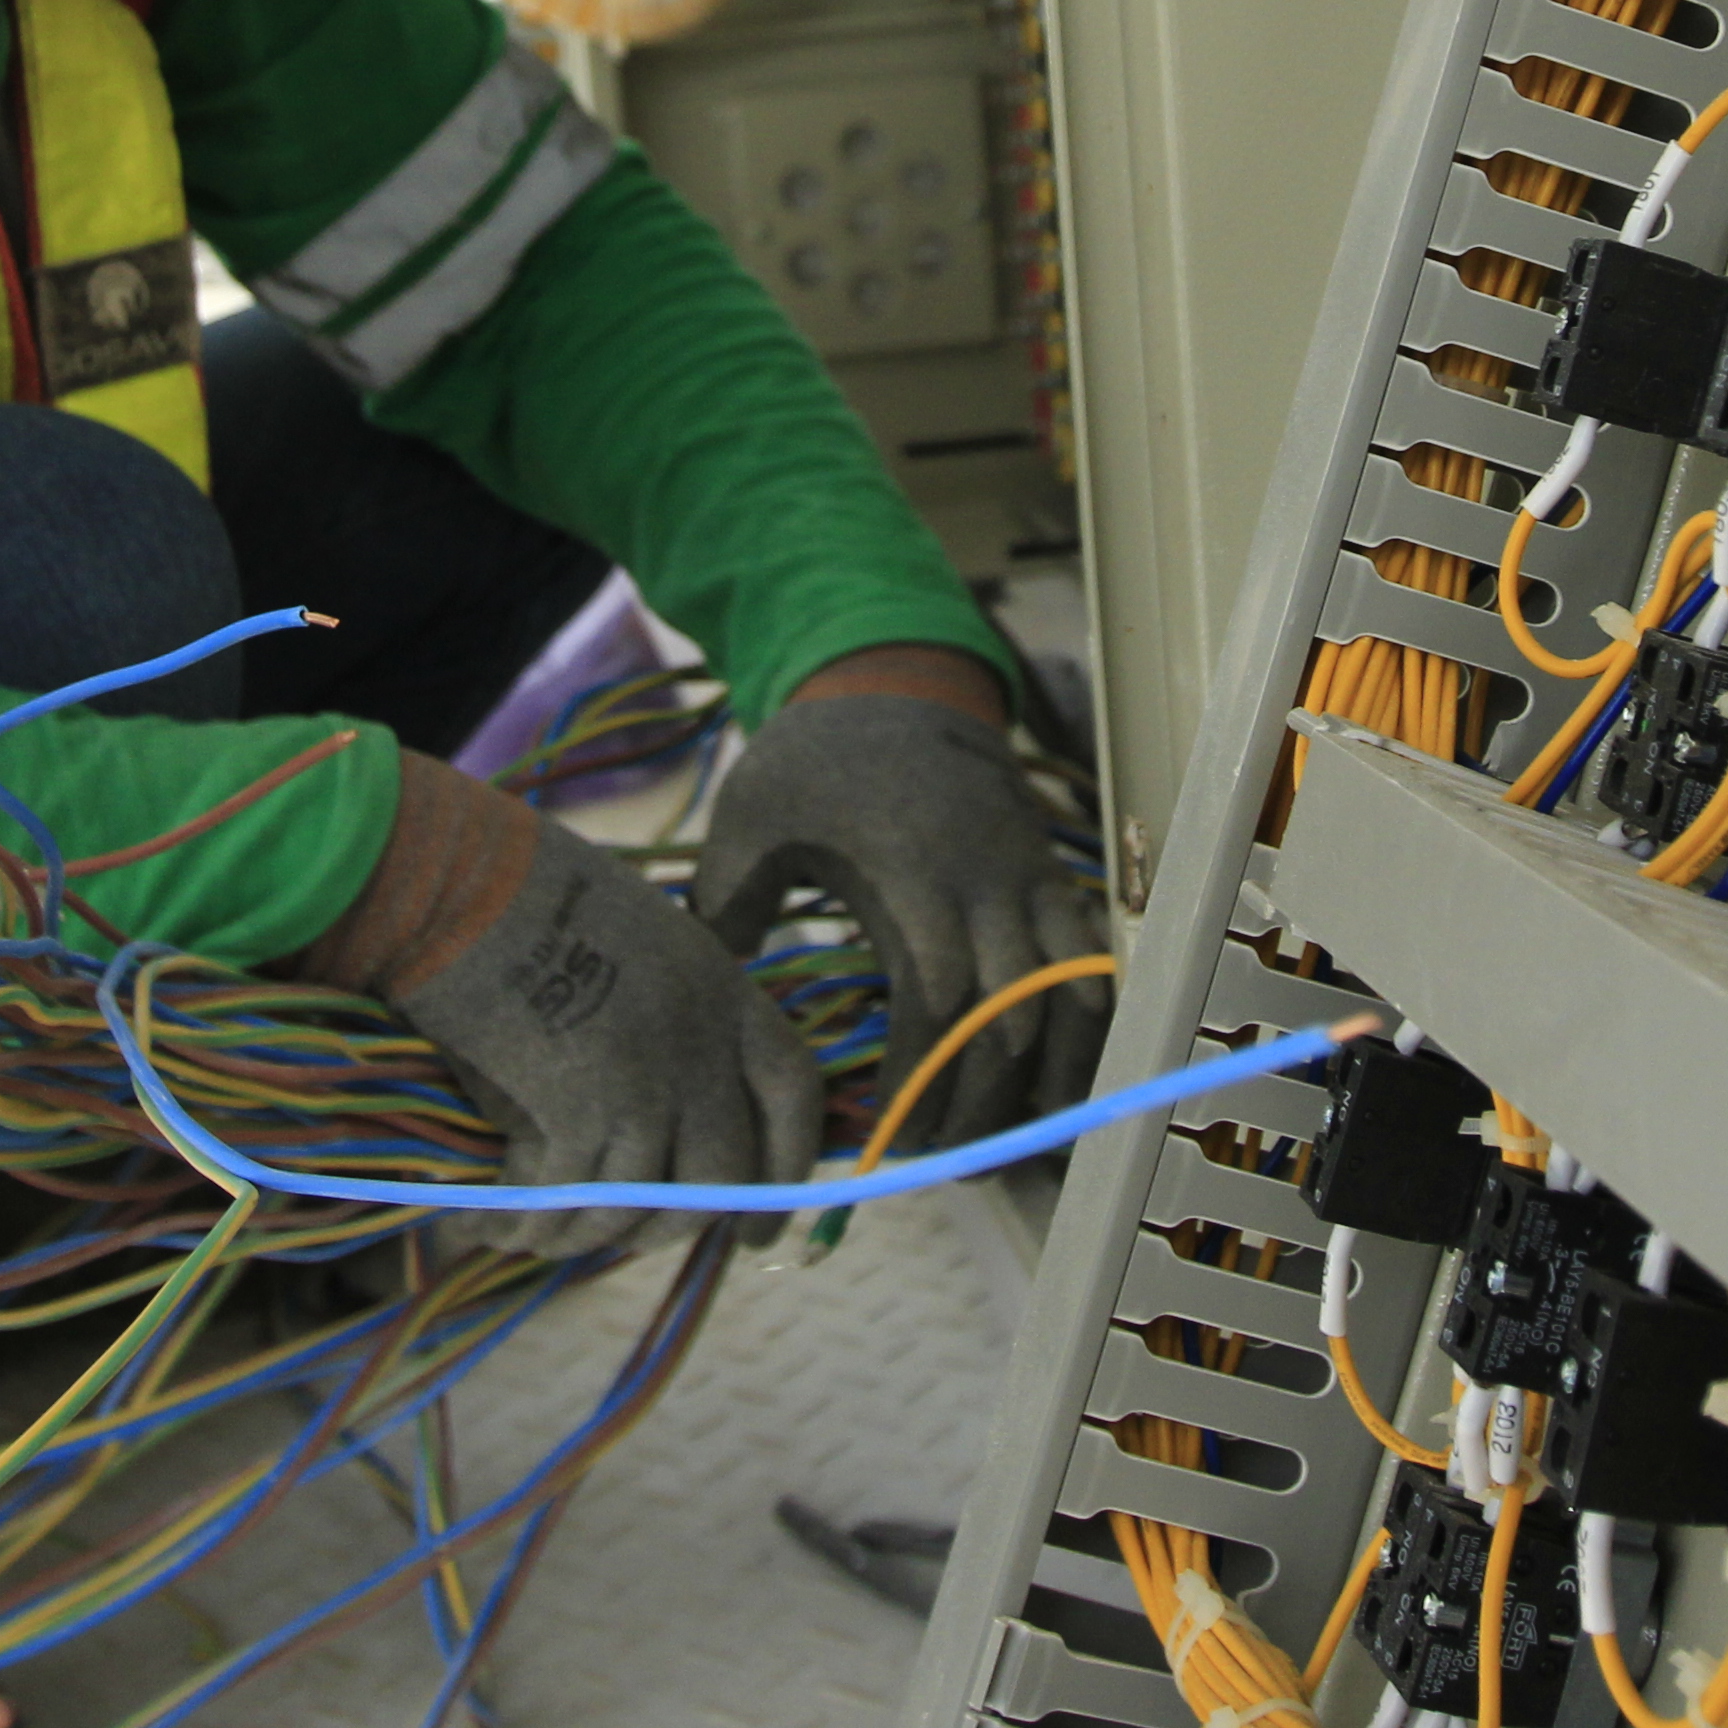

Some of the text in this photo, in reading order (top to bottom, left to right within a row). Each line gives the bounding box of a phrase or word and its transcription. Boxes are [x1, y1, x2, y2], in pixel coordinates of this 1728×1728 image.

[1574, 285, 1590, 317] NO
[1337, 1089, 1353, 1123] NO
[1549, 1248, 1588, 1355] LAY5-BE101C
[1528, 1294, 1553, 1347] .4(NO)
[1491, 1400, 1518, 1454] 2103
[1396, 1529, 1413, 1565] NO
[1556, 1564, 1577, 1594] CE
[1503, 1605, 1531, 1666] FORT
[1448, 1649, 1463, 1681] AC15
